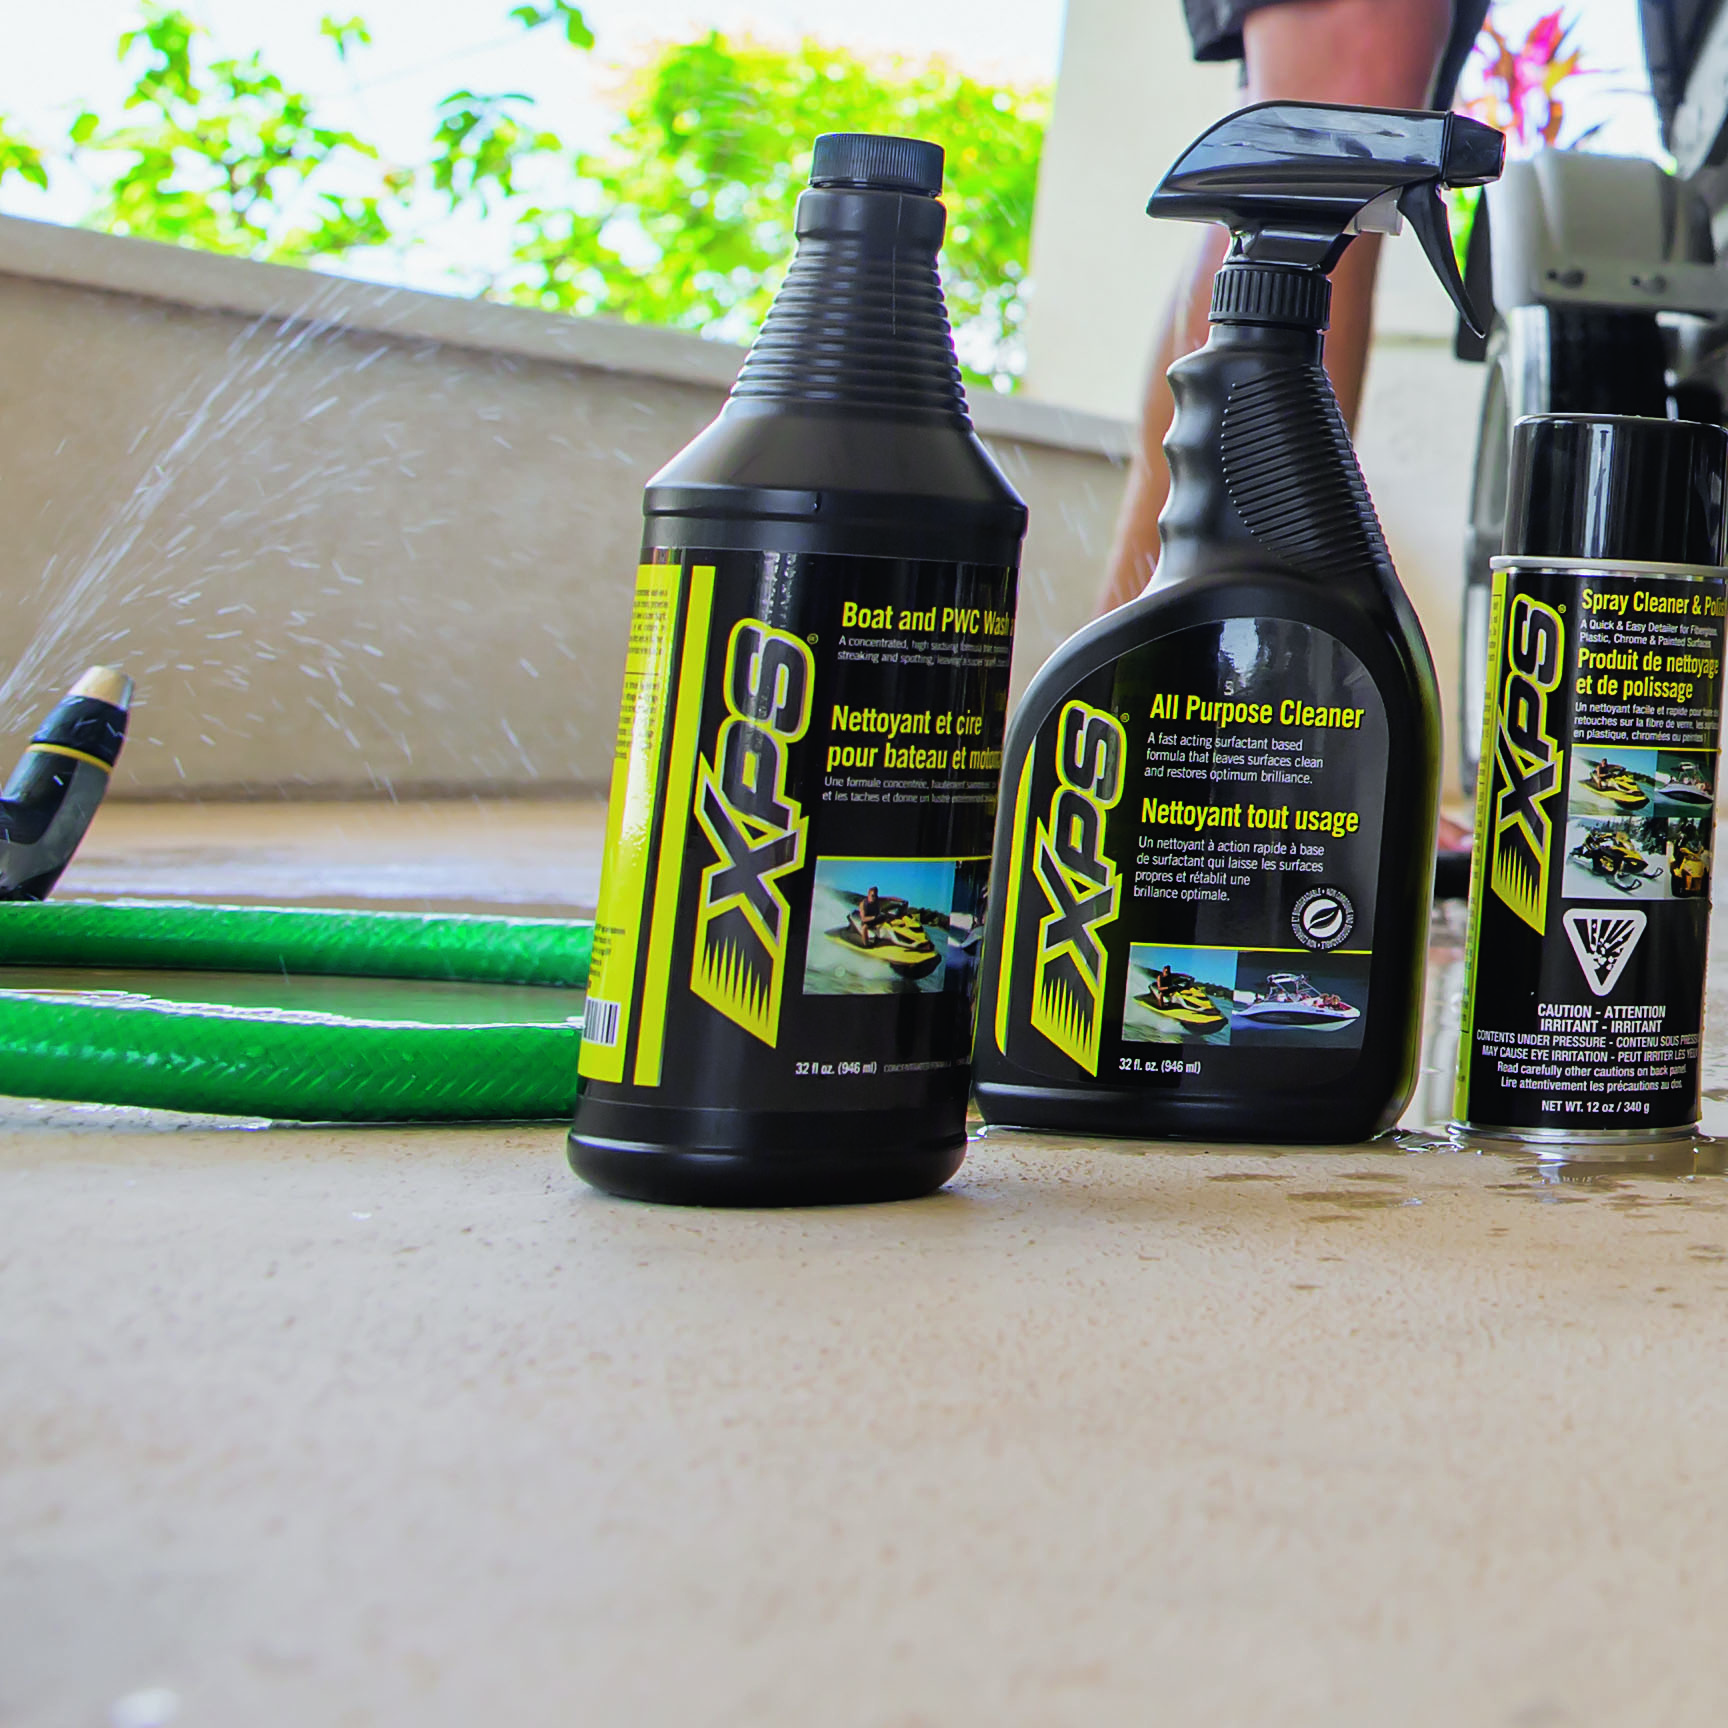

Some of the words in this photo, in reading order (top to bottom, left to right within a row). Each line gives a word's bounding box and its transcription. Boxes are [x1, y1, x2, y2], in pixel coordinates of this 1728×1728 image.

[1582, 588, 1629, 615] Spray
[1633, 591, 1689, 615] Cleaner
[1692, 595, 1701, 615] &
[842, 601, 893, 629] Boat
[899, 607, 936, 631] and
[942, 608, 979, 634] PWC
[984, 610, 1009, 635] Wash
[1578, 647, 1638, 670] Produit
[1643, 651, 1662, 671] de
[1667, 655, 1719, 679] nettoyage
[1576, 675, 1592, 695] et
[1597, 675, 1618, 695] de
[1623, 676, 1693, 703] polissage
[1150, 694, 1179, 719] All
[1186, 695, 1273, 728] Purpose
[1280, 700, 1365, 728] Cleaner
[831, 705, 931, 739] Nettoyant
[936, 712, 952, 735] et
[956, 710, 982, 735] cire
[1495, 593, 1564, 850] XPS
[1148, 732, 1155, 744] A
[1159, 733, 1177, 745] fast
[1180, 734, 1212, 748] acting
[1215, 736, 1268, 749] surfactant
[1271, 738, 1303, 751] based
[827, 746, 878, 772] pour
[884, 742, 948, 769] bateau
[952, 747, 966, 770] et
[1146, 748, 1185, 762] formula
[1189, 751, 1209, 763] that
[1213, 752, 1244, 765] leaves
[1248, 754, 1291, 767] surfaces
[1295, 756, 1323, 768] clean
[1144, 766, 1164, 777] and
[1167, 767, 1207, 779] restores
[1210, 769, 1257, 782] optimum
[1261, 770, 1312, 784] brilliance.
[694, 617, 815, 961] XPS
[1142, 798, 1241, 831] Nettoyant
[1248, 804, 1289, 829] tout
[1295, 810, 1359, 837] usage
[1033, 699, 1127, 997] XPS
[1138, 836, 1153, 848] Un
[1157, 837, 1204, 852] nettoyant
[1209, 839, 1214, 851] à
[1218, 841, 1250, 853] action
[1253, 842, 1286, 855] rapide
[1290, 843, 1296, 854] à
[1300, 843, 1325, 856] base
[1137, 852, 1149, 864] de
[1152, 853, 1204, 867] surfactant
[1208, 857, 1225, 869] qui
[1228, 857, 1257, 869] laisse
[1261, 858, 1276, 870] les
[1279, 859, 1323, 872] surfaces
[1135, 871, 1173, 883] propres
[1176, 871, 1186, 883] et
[1190, 871, 1226, 885] rétablit
[1230, 874, 1250, 886] une
[1134, 885, 1178, 899] brillance
[1181, 887, 1230, 901] optimale.
[1538, 1004, 1592, 1018] CAUTION
[1604, 1005, 1666, 1019] ATTENTION
[1540, 1019, 1599, 1033] IRRITANT
[1611, 1020, 1662, 1033] IRRITANT
[796, 1062, 809, 1074] 32
[821, 1063, 835, 1074] oz.
[838, 1062, 860, 1075] (946
[863, 1061, 877, 1074] ml)
[1119, 1058, 1132, 1071] 32
[1135, 1059, 1143, 1071] fl.
[1145, 1060, 1159, 1072] oz.
[1161, 1059, 1184, 1073] (946
[1186, 1060, 1201, 1074] ml)
[1542, 1101, 1562, 1112] NET
[1565, 1101, 1583, 1112] WT.
[1587, 1101, 1599, 1112] 12
[1602, 1104, 1614, 1112] oz
[1616, 1102, 1621, 1112] /
[1624, 1101, 1641, 1112] 340
[1643, 1103, 1650, 1114] g
